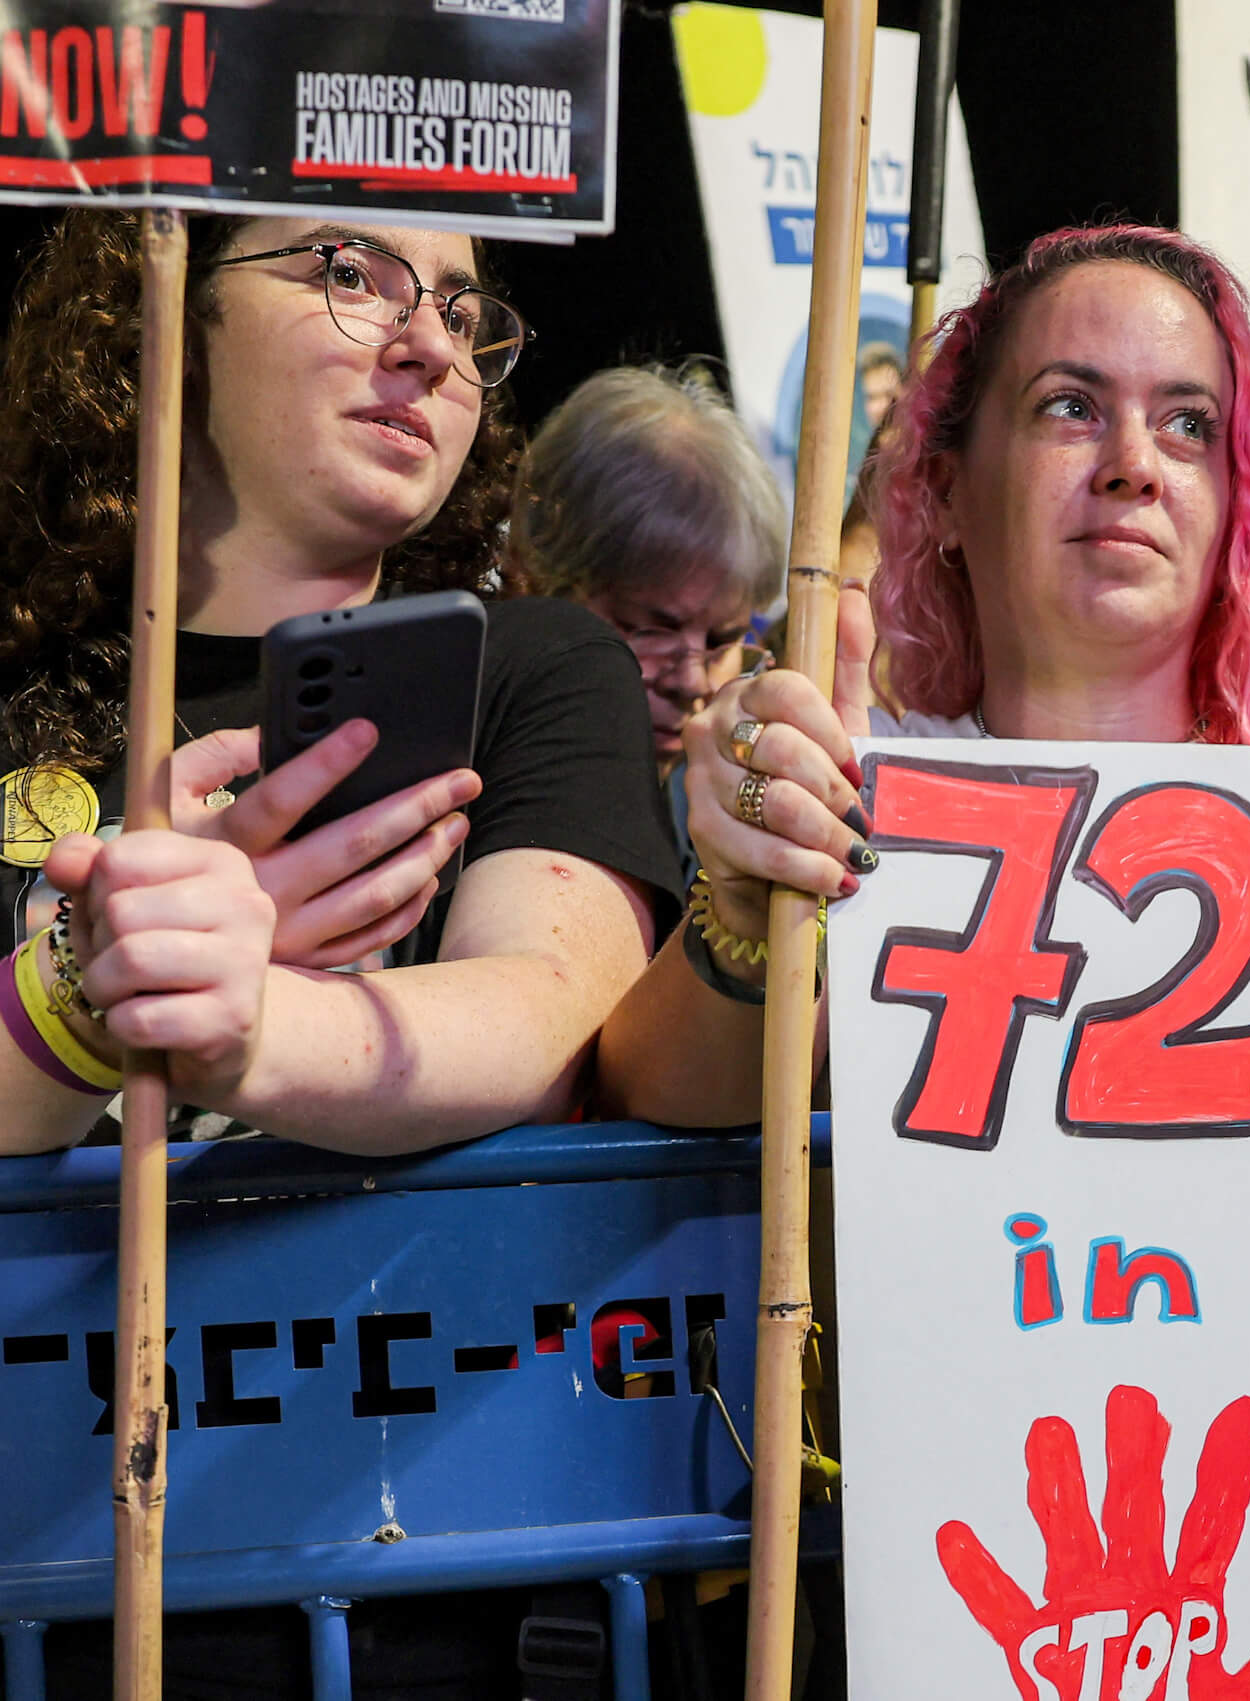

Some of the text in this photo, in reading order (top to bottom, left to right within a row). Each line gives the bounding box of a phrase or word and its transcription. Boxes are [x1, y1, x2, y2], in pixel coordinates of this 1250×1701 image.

[0, 12, 211, 140] NOW!
[297, 71, 572, 126] HOSTAGES AND MISSING
[296, 110, 572, 181] FAMILIES FORUM
[1003, 1212, 1201, 1330] in
[1018, 1600, 1221, 1701] STOP
